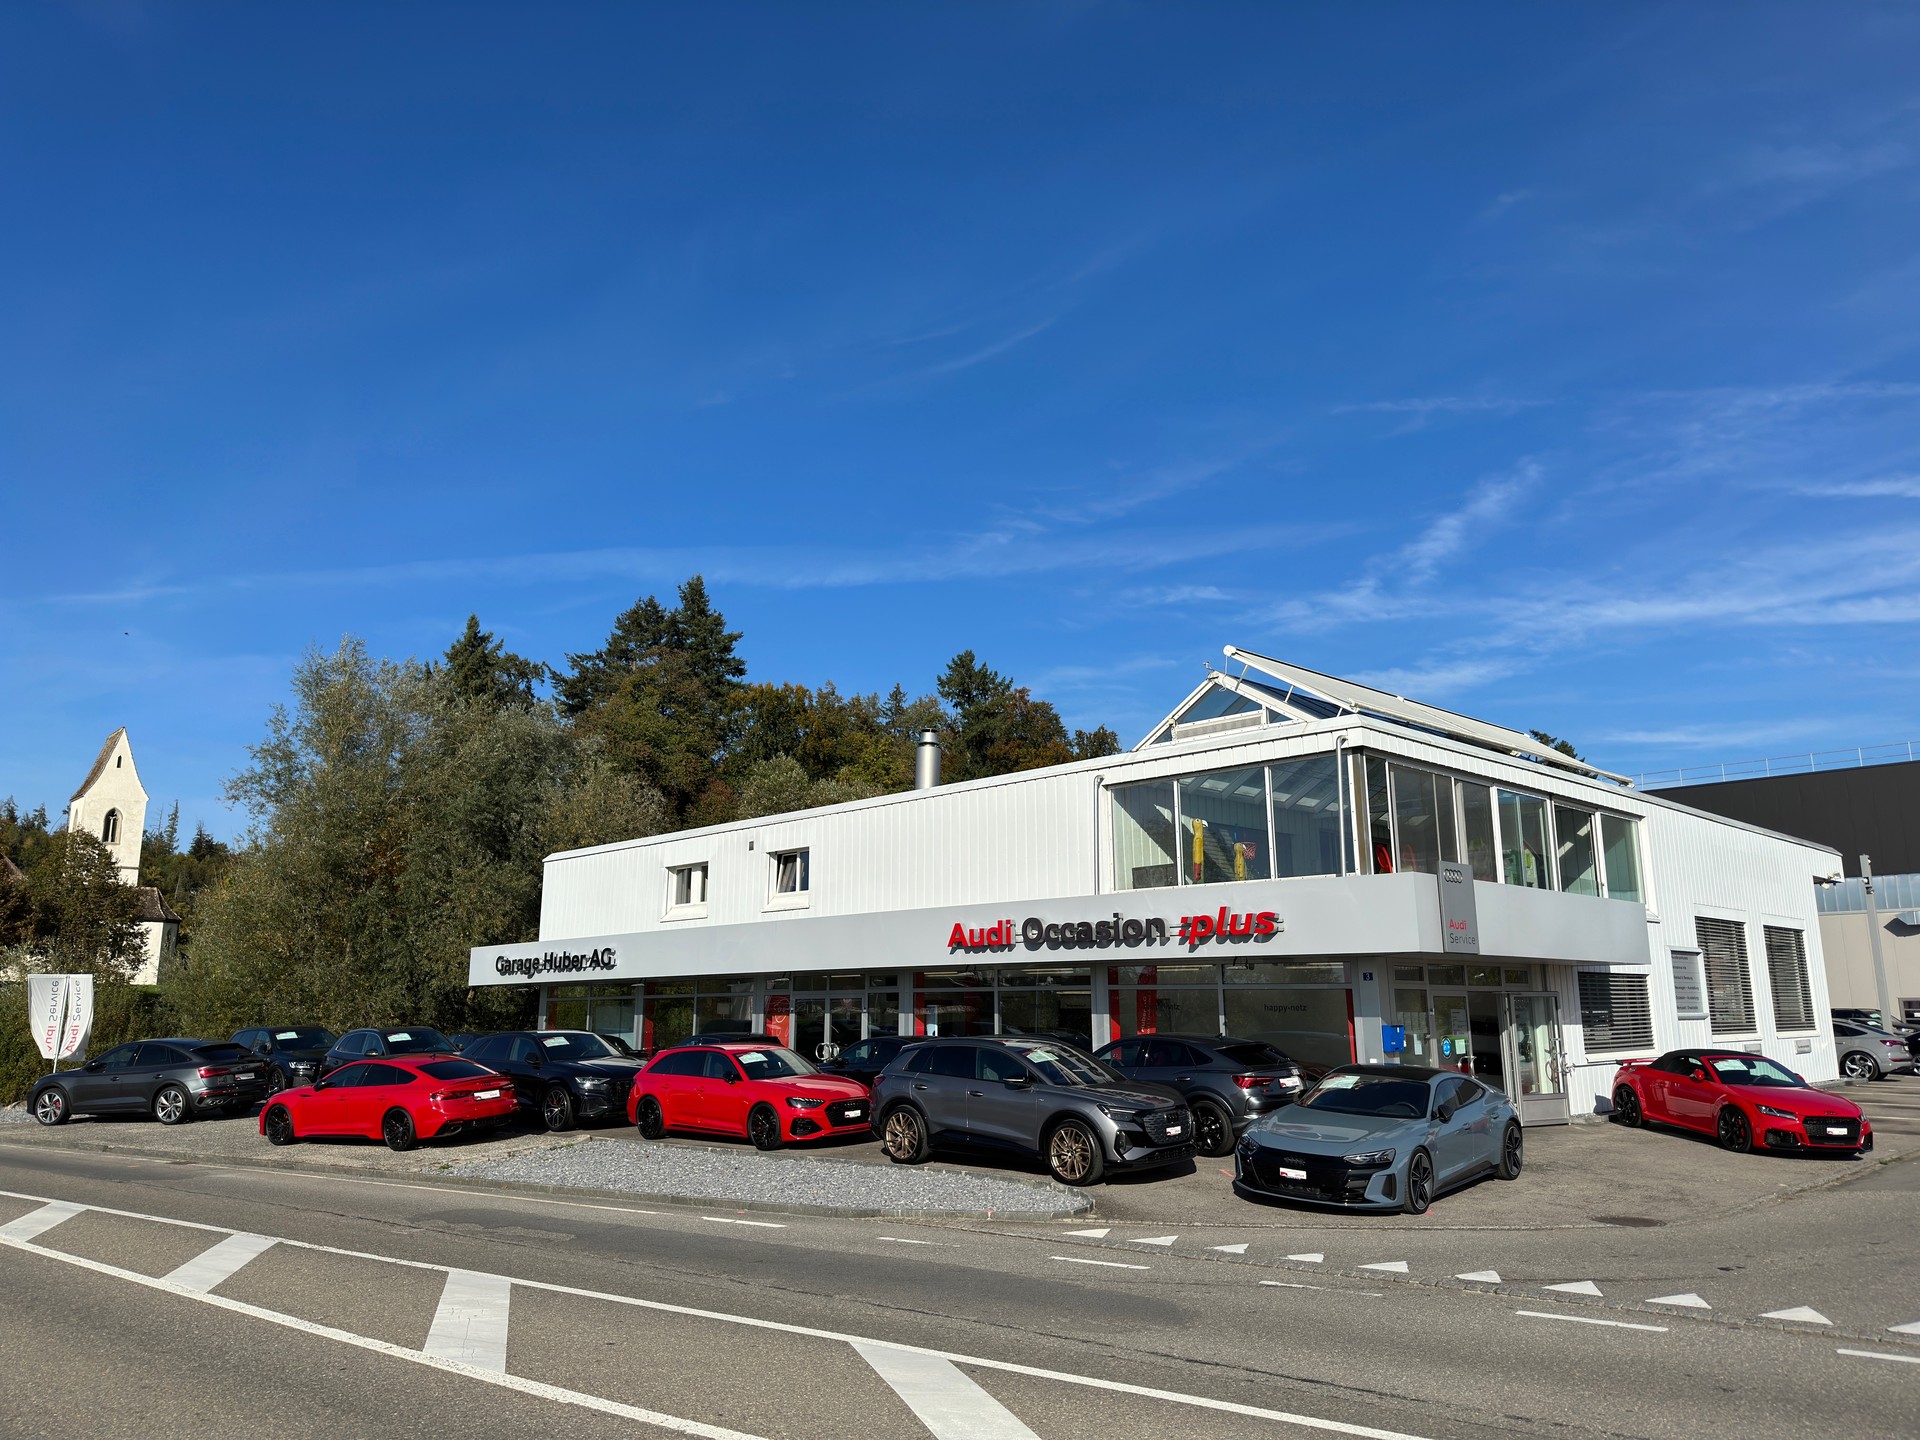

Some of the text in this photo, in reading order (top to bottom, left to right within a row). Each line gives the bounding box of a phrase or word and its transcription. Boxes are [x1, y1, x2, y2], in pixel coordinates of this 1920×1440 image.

[947, 921, 1014, 947] Audi
[1022, 913, 1167, 943] Occasion
[1449, 919, 1467, 930] Audi
[1449, 933, 1476, 945] Service
[495, 947, 614, 975] Garage Huber AG
[66, 980, 81, 1052] Audi Service
